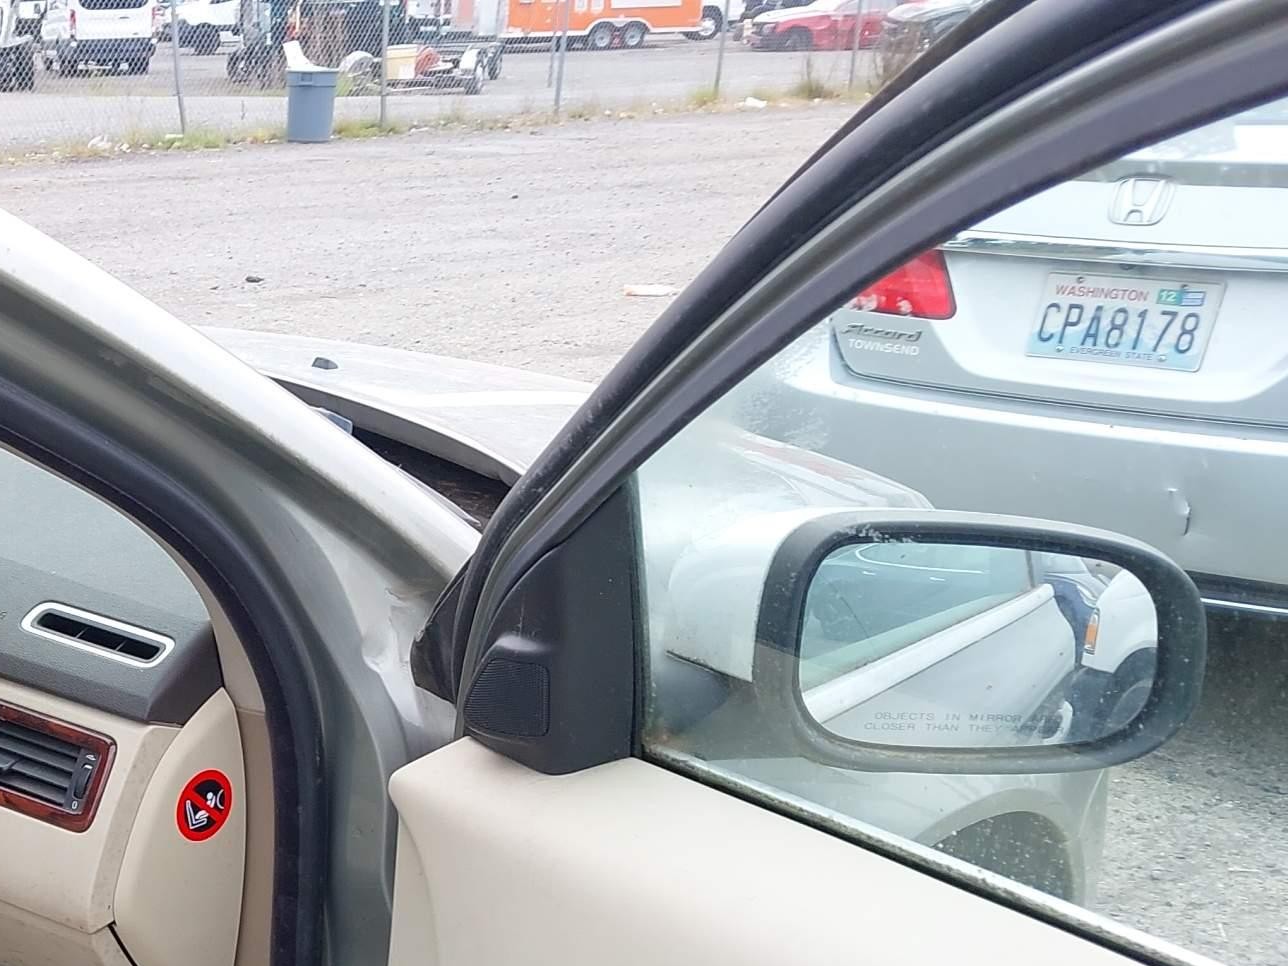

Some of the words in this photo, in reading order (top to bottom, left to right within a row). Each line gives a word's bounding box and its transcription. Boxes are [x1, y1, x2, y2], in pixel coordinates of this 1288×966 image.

[1055, 284, 1150, 302] WASHINGTON
[1160, 290, 1177, 302] 12
[842, 323, 922, 342] Accord
[1037, 302, 1201, 354] CPA8178
[848, 338, 920, 356] TOWNSEND
[1125, 351, 1154, 361] STATE
[874, 711, 936, 721] OBJECTS
[946, 713, 961, 721] IN
[968, 713, 1023, 722] MIRROR
[863, 722, 916, 731] CLOSER
[926, 723, 961, 732] THAN
[968, 724, 1003, 733] THEY
